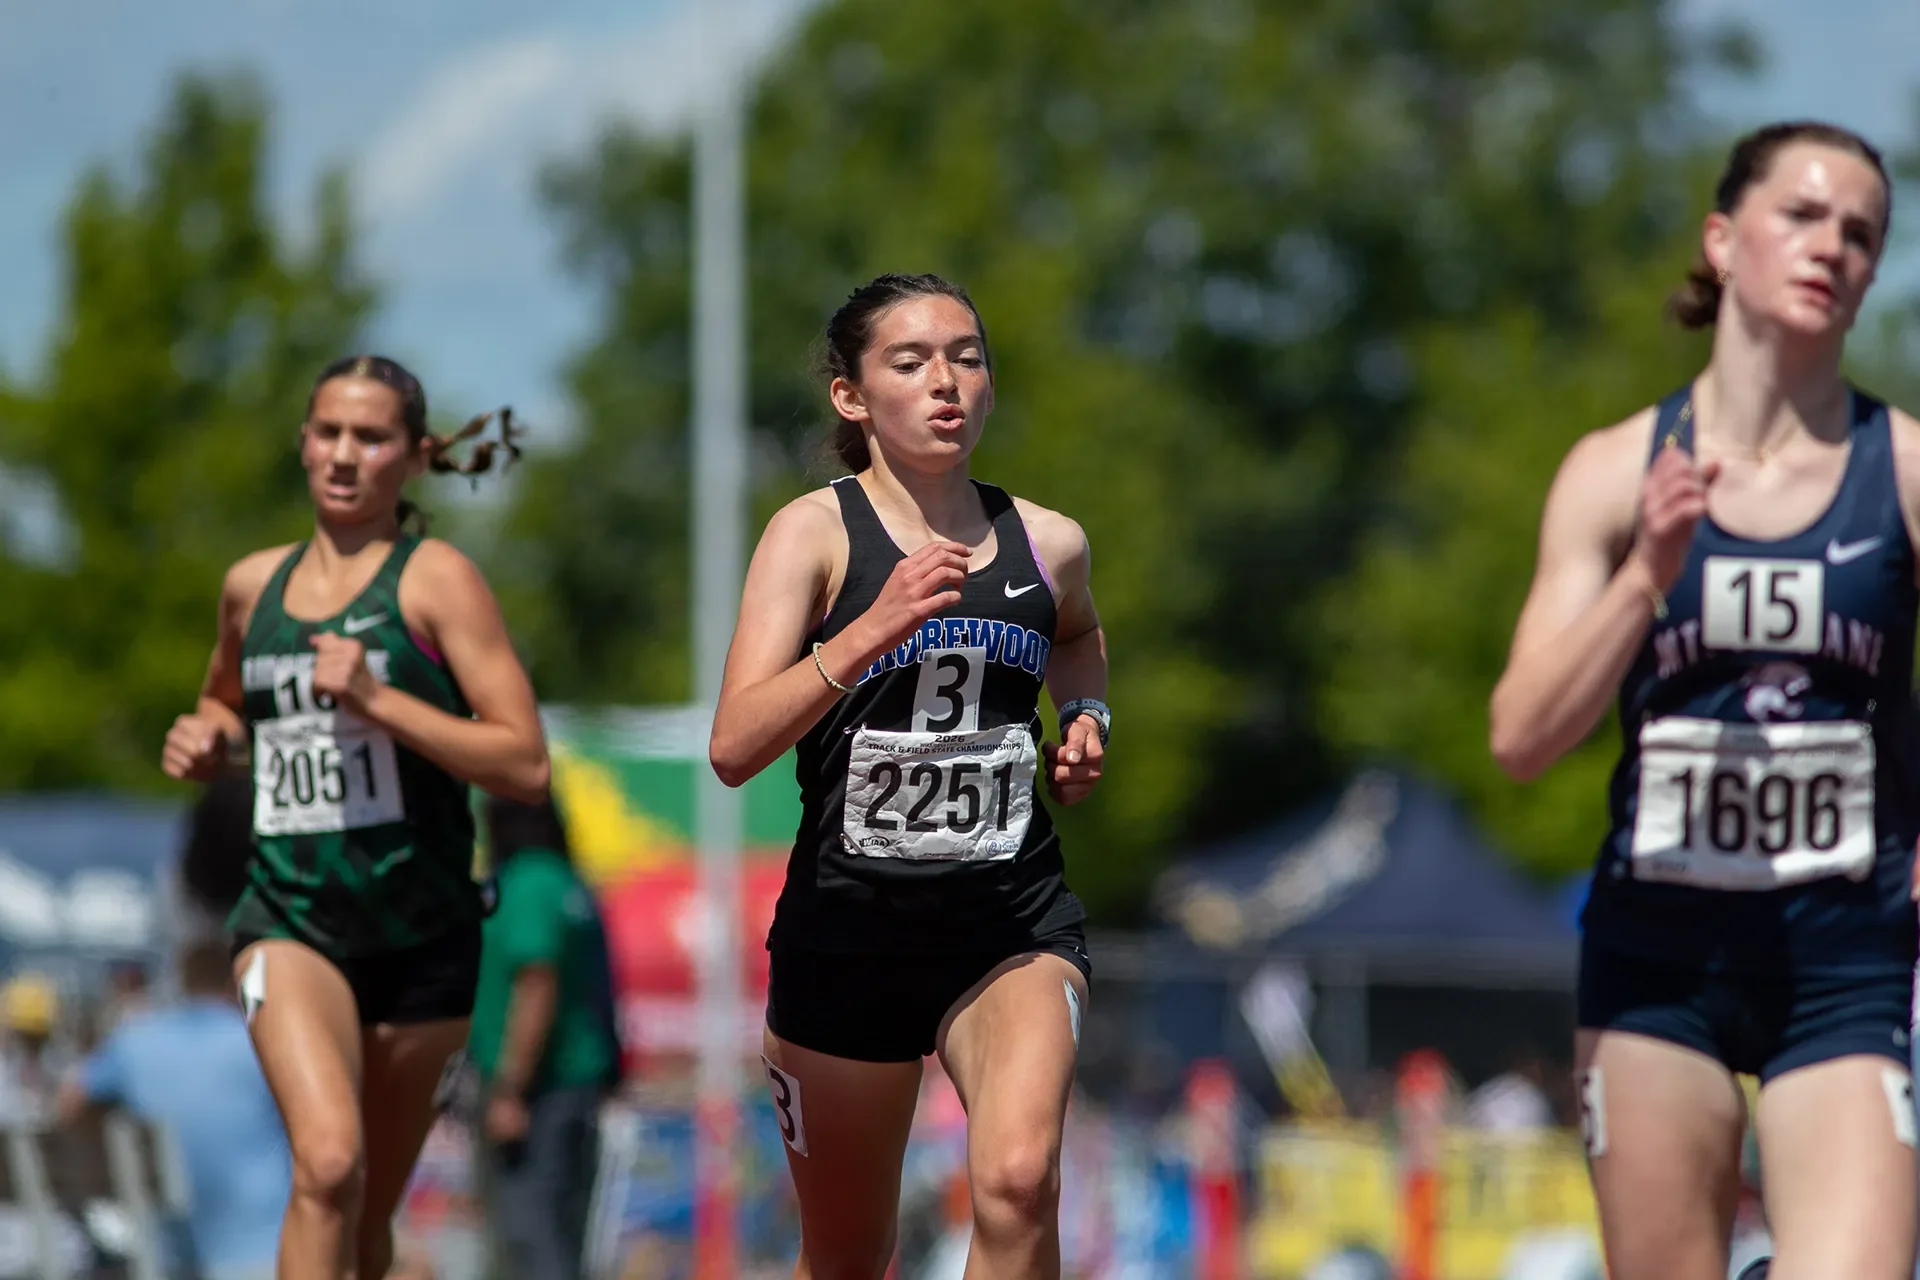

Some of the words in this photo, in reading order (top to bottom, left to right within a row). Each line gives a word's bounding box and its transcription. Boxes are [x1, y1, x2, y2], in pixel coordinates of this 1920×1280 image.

[1730, 569, 1800, 641] 15
[926, 653, 970, 733] 3
[868, 743, 896, 753] TRACK
[906, 746, 930, 754] FIELD
[956, 742, 1021, 753] CHAMPIONSHIPS
[935, 734, 965, 743] 2026
[271, 741, 377, 809] 2051
[864, 761, 1013, 834] 2251
[1670, 767, 1842, 852] 1696
[769, 1067, 796, 1143] 3
